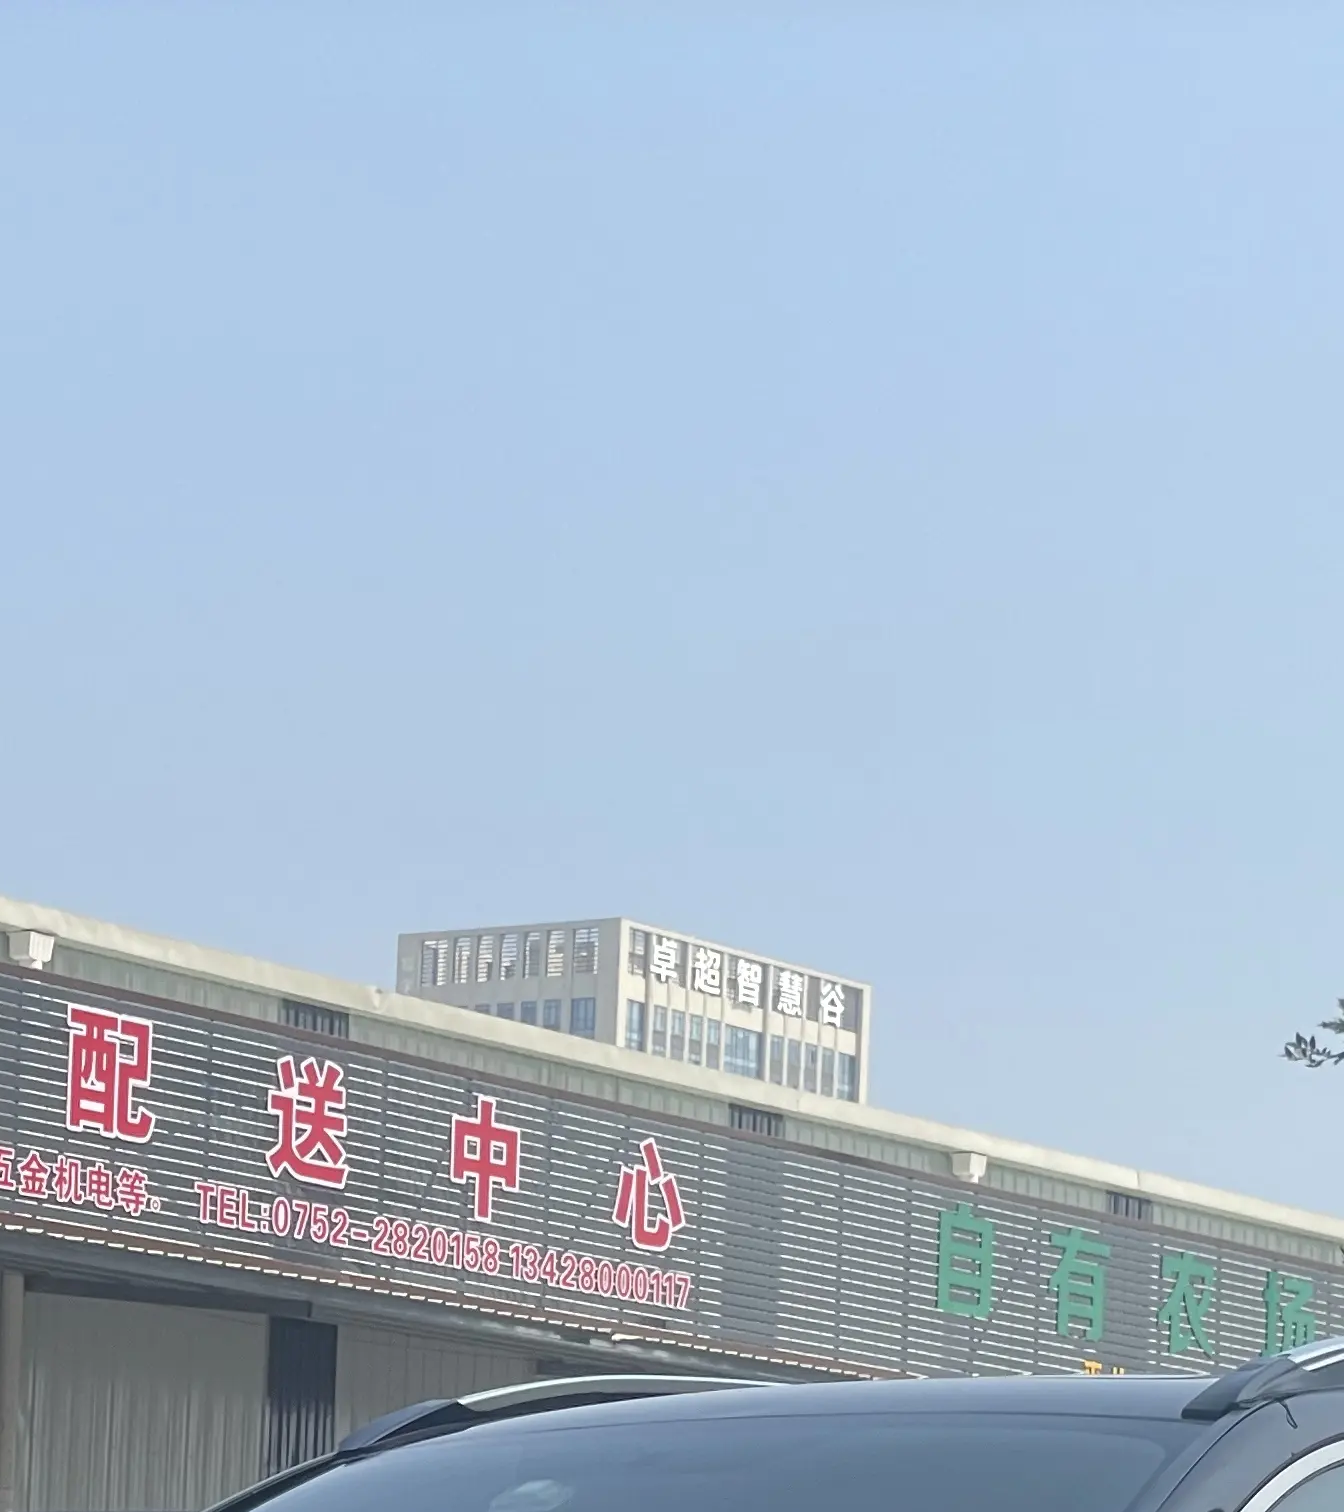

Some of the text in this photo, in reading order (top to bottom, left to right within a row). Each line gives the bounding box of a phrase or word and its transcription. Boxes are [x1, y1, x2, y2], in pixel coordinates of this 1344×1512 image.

[650, 937, 845, 1028] 卓超智慧谷
[509, 1244, 691, 1310] 13428000117
